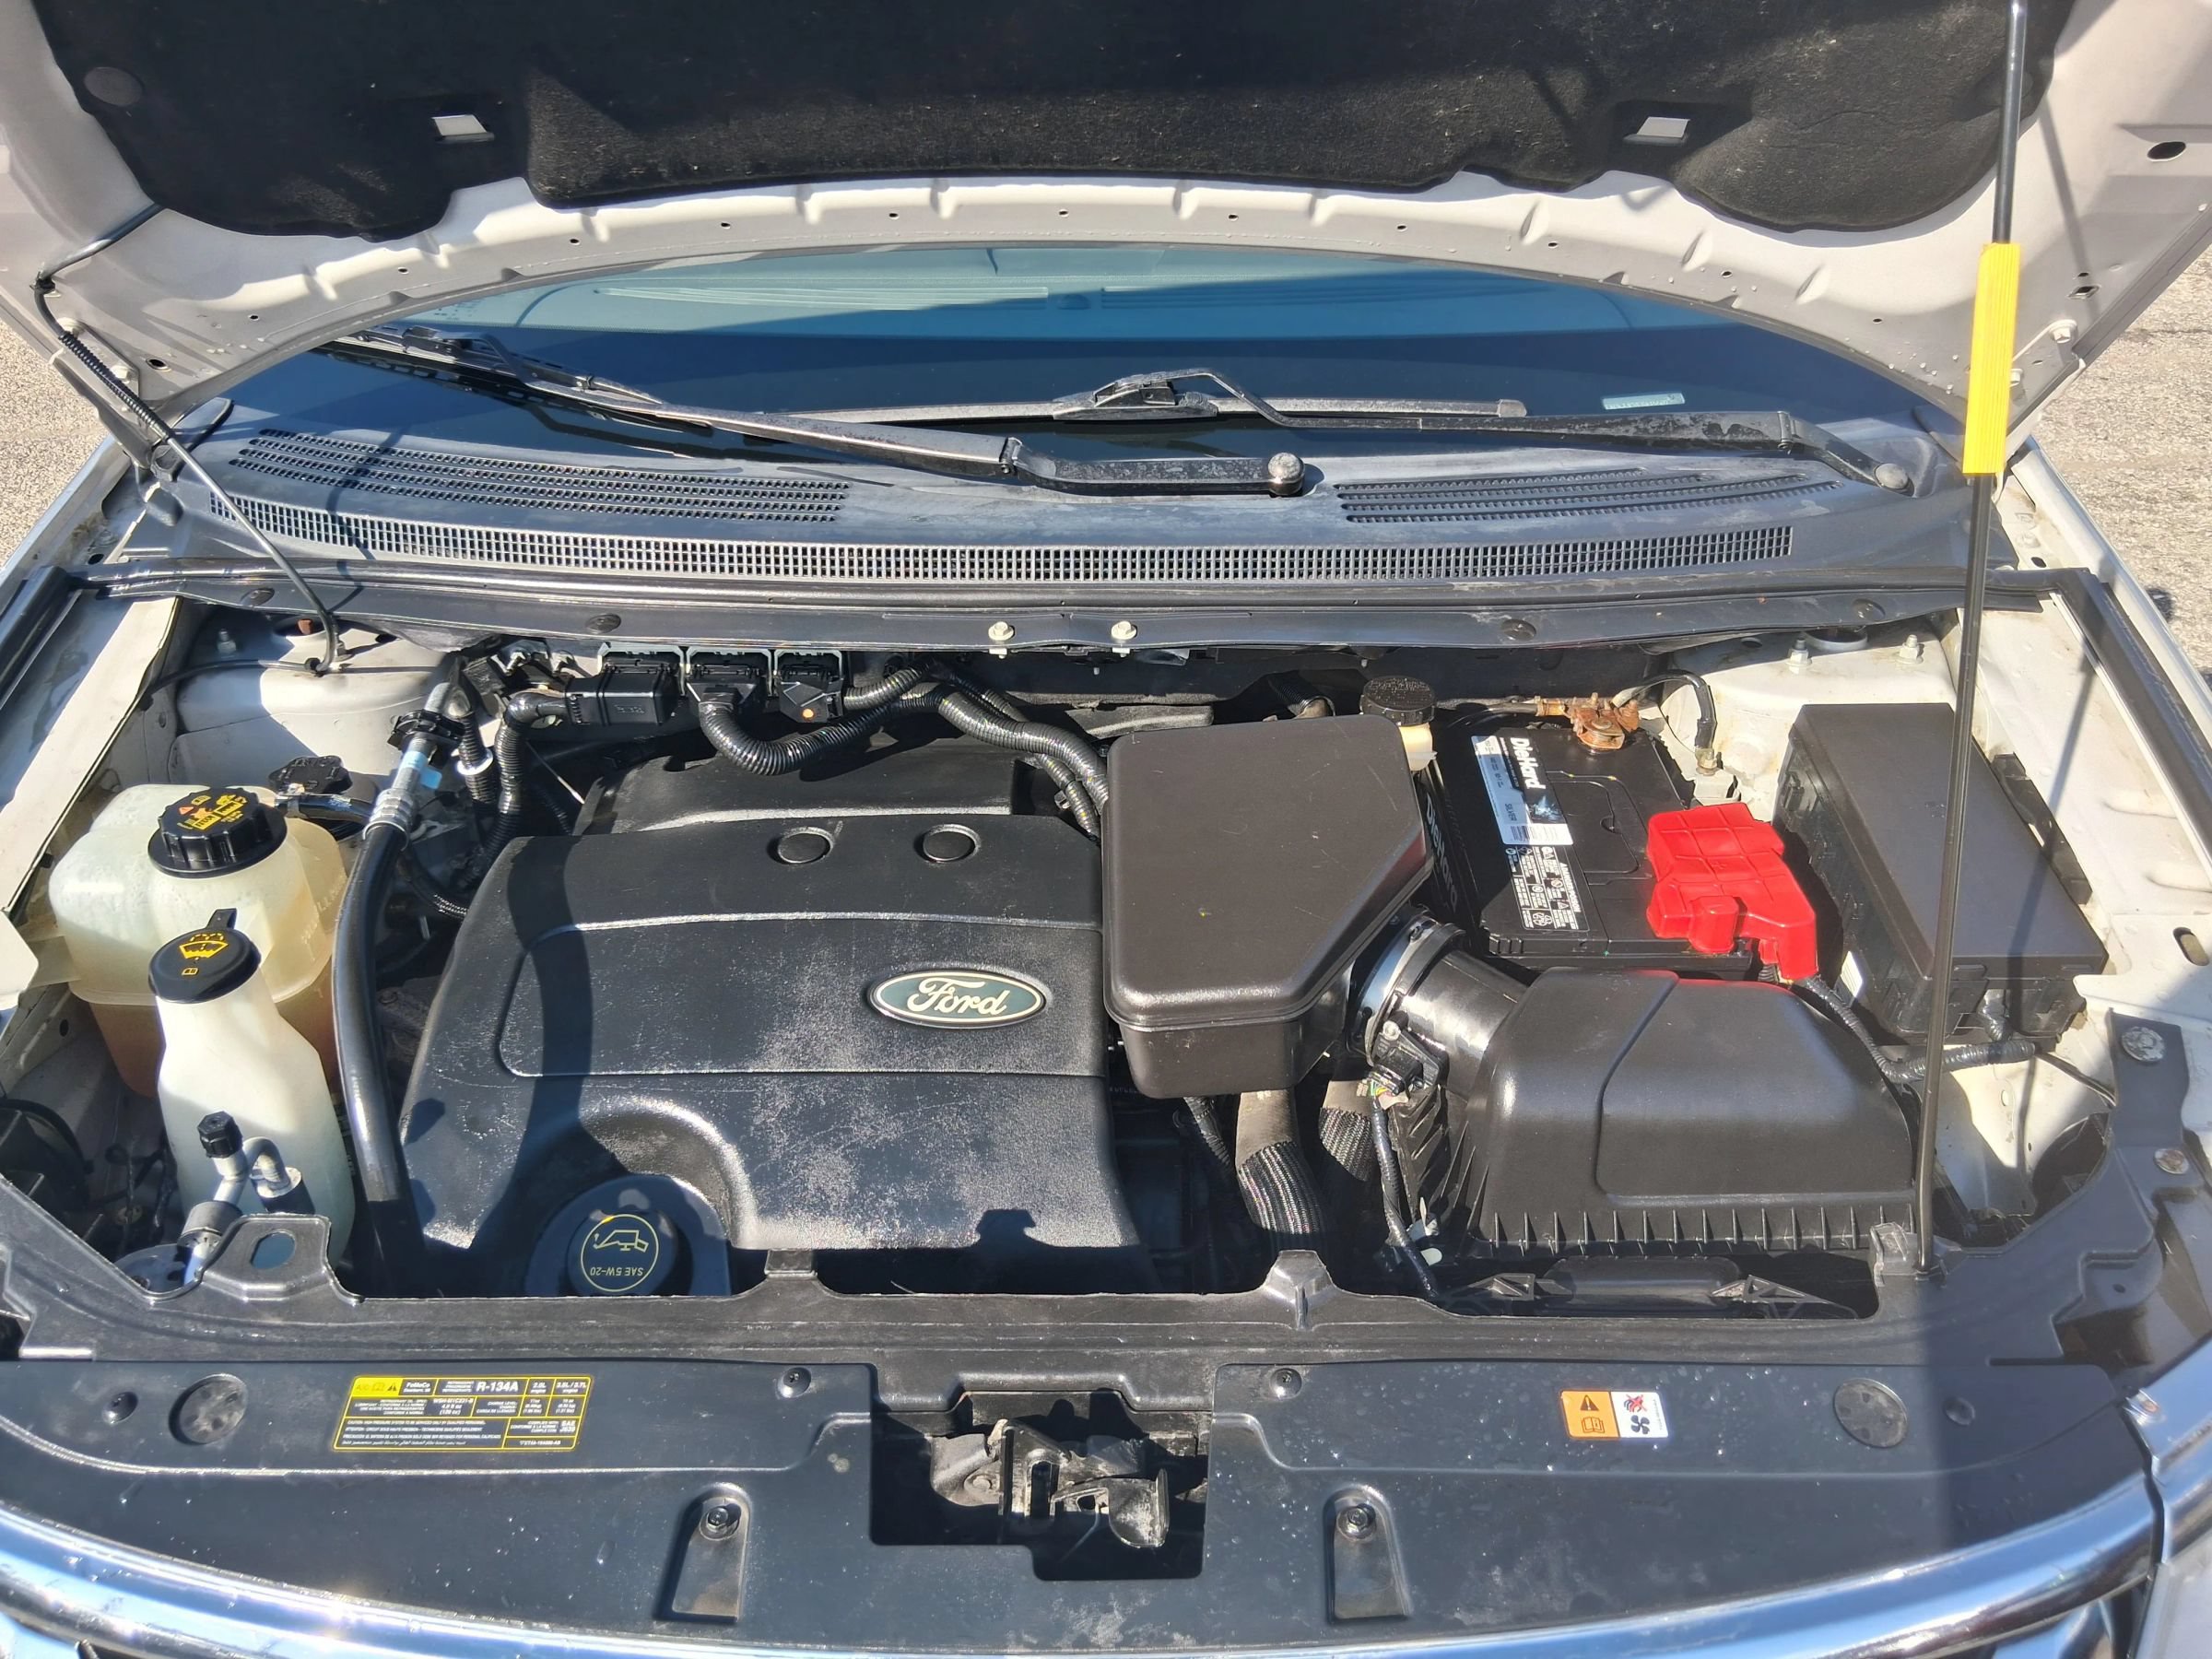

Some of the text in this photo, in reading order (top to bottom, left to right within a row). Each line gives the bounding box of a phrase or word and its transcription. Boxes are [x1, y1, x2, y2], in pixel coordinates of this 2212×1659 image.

[1510, 737, 1547, 790] DieHard
[1504, 803, 1517, 821] SILVER
[907, 977, 1011, 1016] Ford
[590, 1266, 644, 1277] SAE 5W-20
[476, 1381, 519, 1393] R-134A
